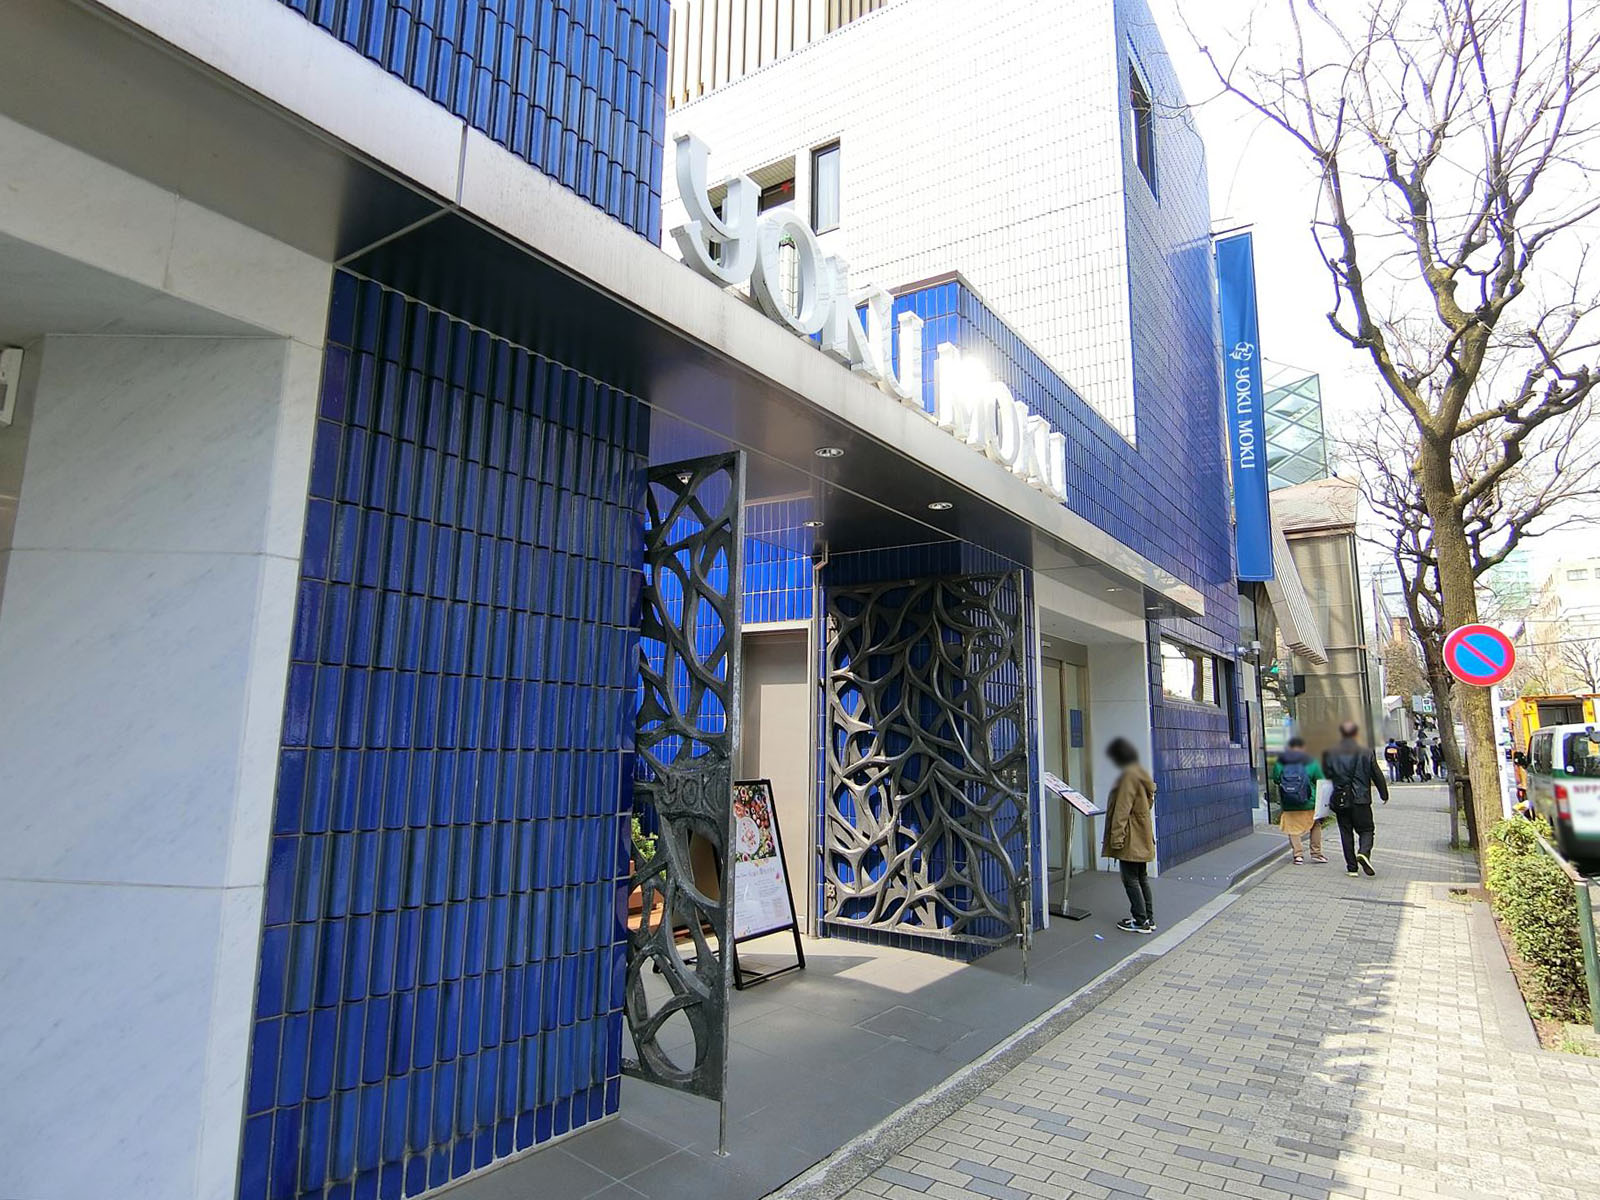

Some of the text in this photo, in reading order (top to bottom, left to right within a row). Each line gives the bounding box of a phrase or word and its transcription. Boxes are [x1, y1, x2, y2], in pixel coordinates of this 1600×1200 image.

[669, 130, 1068, 504] YOKU MOKU
[1235, 367, 1255, 469] YOKU MOKU
